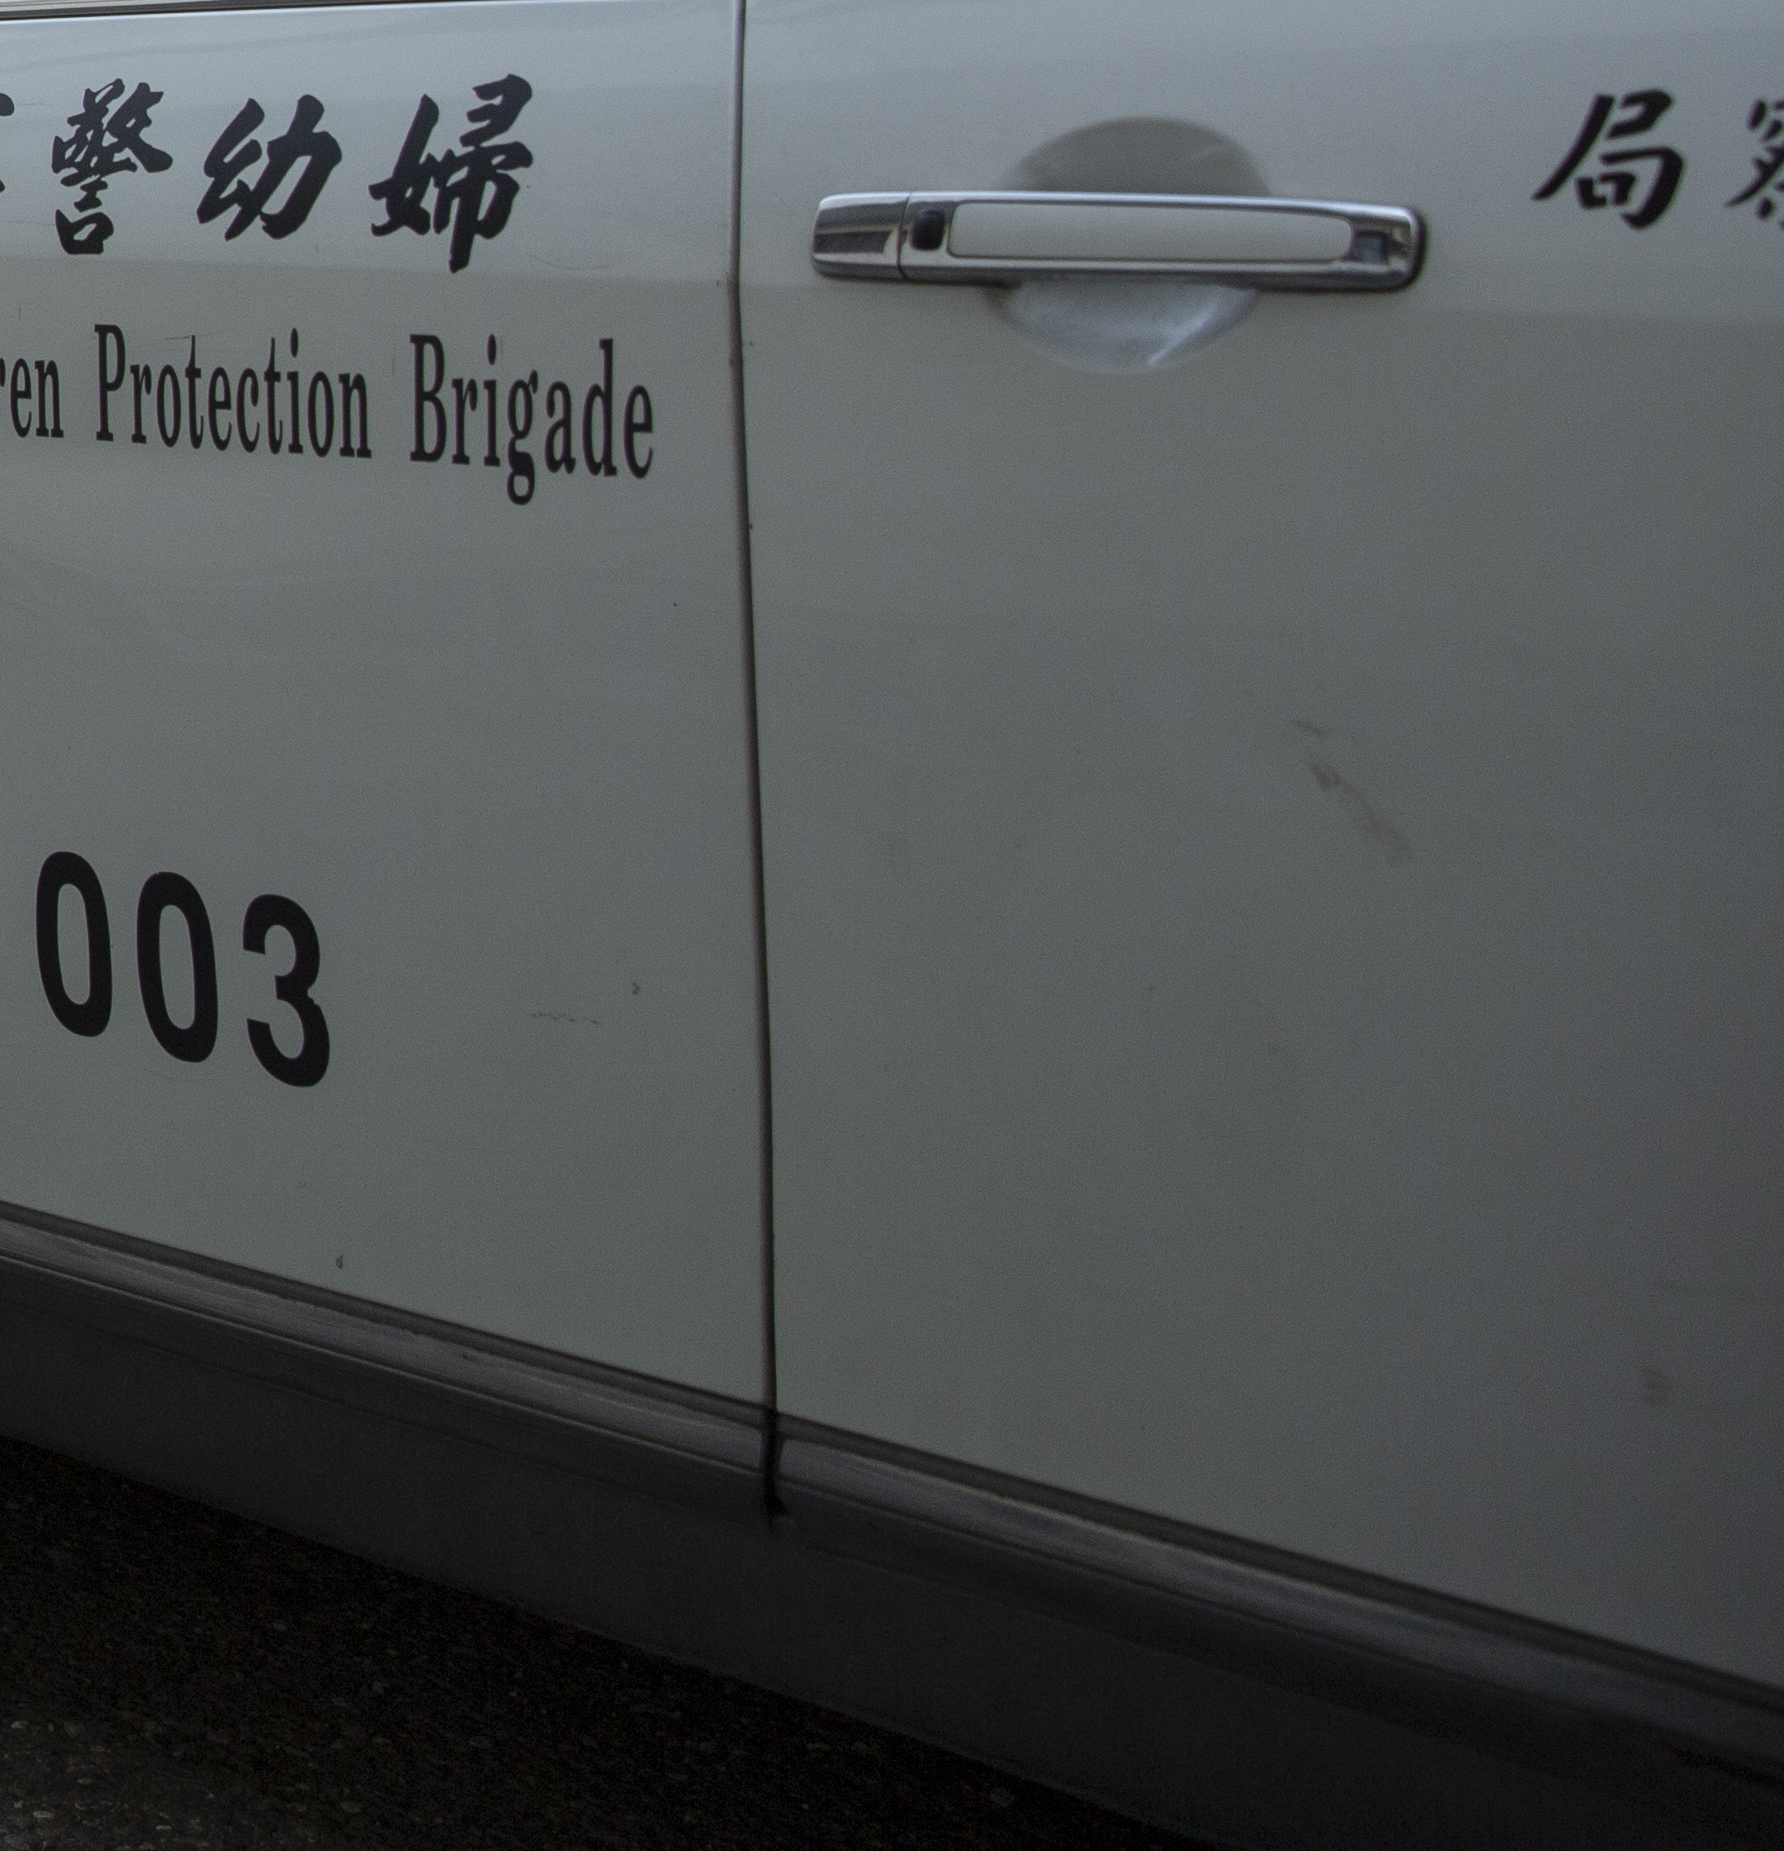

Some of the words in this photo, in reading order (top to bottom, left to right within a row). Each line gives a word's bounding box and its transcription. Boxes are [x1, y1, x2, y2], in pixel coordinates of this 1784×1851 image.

[93, 323, 373, 460] Protection
[409, 334, 654, 507] Brigade
[35, 850, 331, 1089] 003
